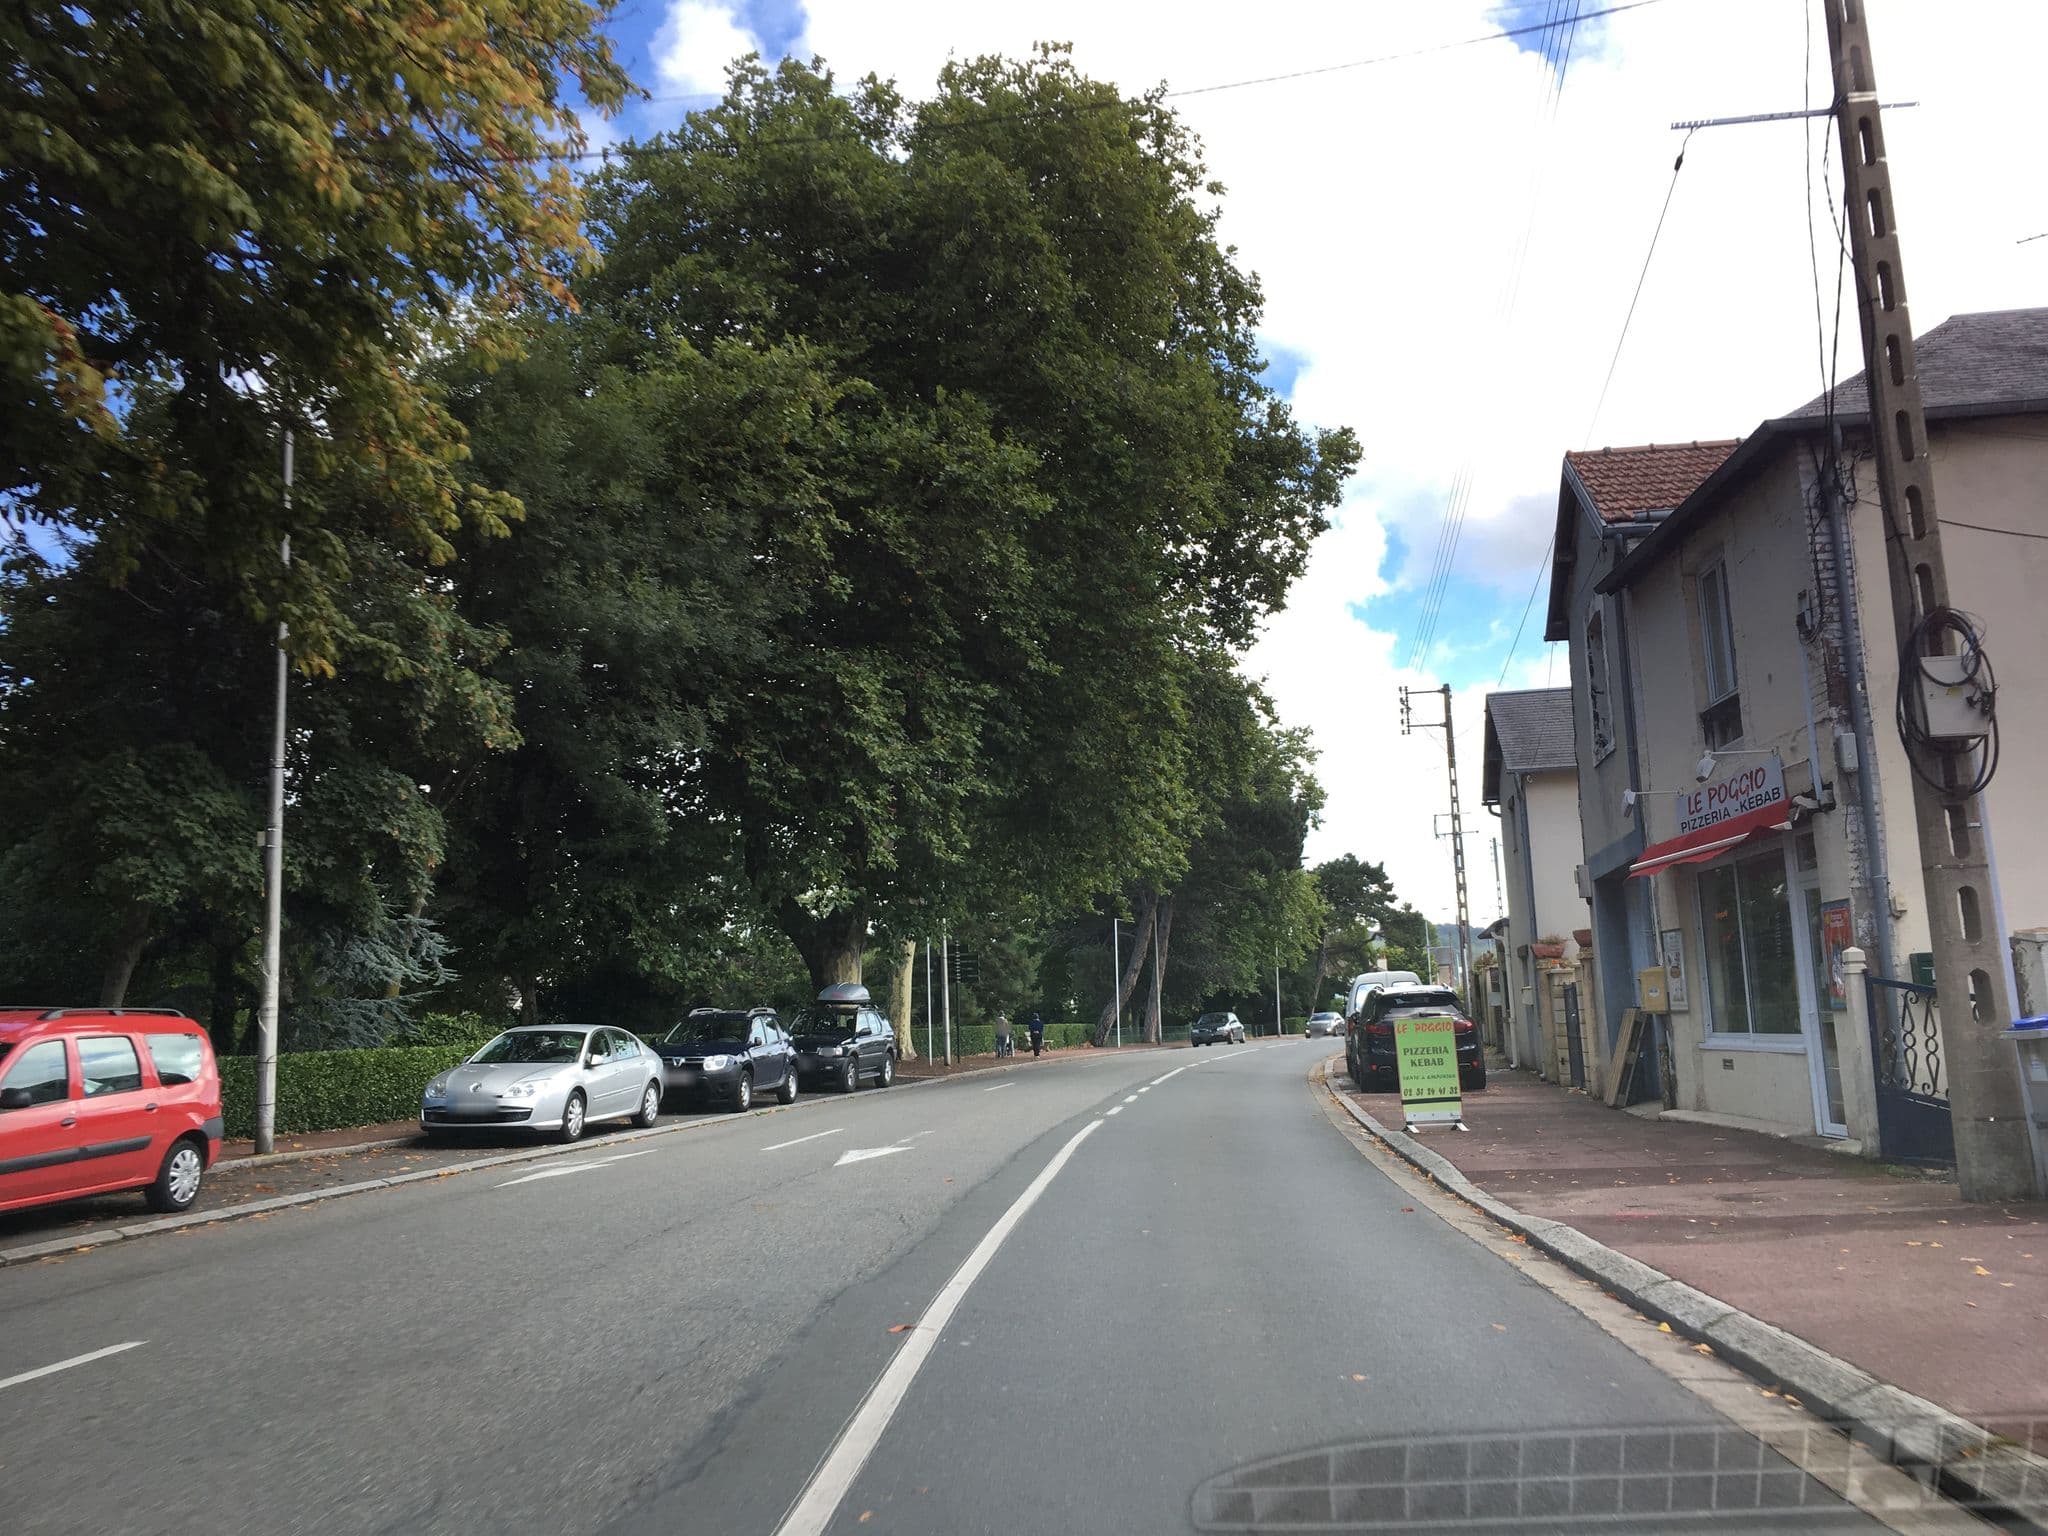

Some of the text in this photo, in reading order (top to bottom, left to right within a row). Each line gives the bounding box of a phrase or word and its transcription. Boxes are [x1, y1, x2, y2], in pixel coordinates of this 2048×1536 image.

[1688, 767, 1766, 815] LE POGGIO
[1680, 807, 1731, 834] PIZZERIA
[1396, 1021, 1452, 1034] LE POGGIO
[1403, 1046, 1449, 1056] PIZZERIA
[1410, 1057, 1444, 1067] KEBAB
